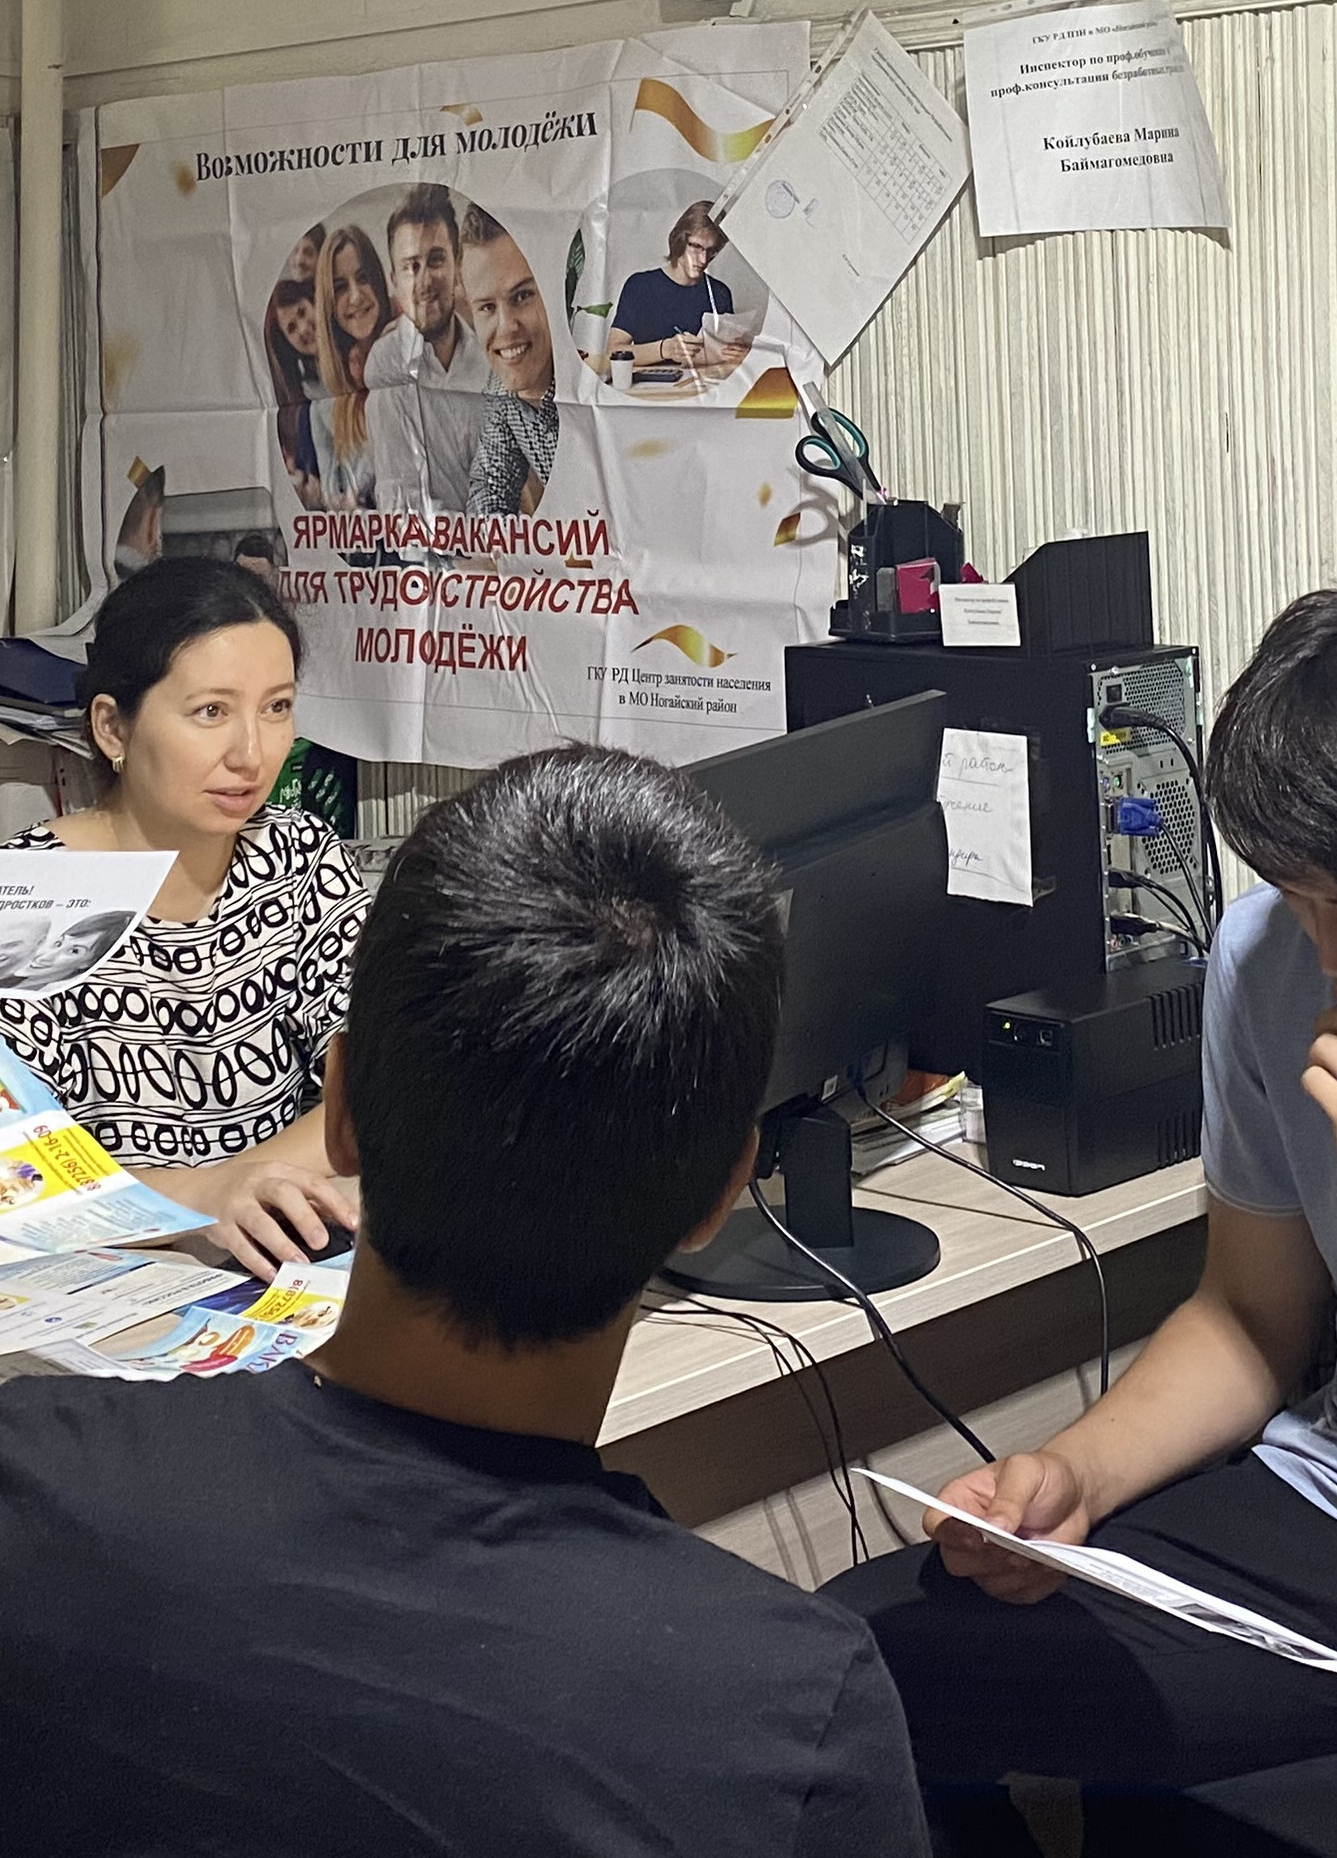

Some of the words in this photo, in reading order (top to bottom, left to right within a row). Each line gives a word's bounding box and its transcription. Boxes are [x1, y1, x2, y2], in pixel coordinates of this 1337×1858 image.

[1020, 58, 1086, 75] Инспектор
[1089, 55, 1104, 66] по
[391, 133, 446, 166] для
[456, 111, 598, 157] молодёжи
[1043, 132, 1130, 151] Койлубаева
[1135, 127, 1180, 143] Марина
[1060, 152, 1174, 172] Баймагомедовна
[293, 513, 427, 549] ЯРМАРКА
[433, 509, 610, 556] ВАКАНСИЙ
[334, 567, 640, 615] ТРУДОУСТРОЙСТВА
[355, 623, 528, 674] МОЛОДЁЖИ
[587, 666, 607, 681] ГКУ
[612, 667, 629, 685] РД
[631, 668, 663, 688] Центр
[664, 674, 714, 688] занятости
[716, 677, 772, 692] населения
[619, 695, 626, 705] в
[629, 692, 649, 706] МО
[650, 693, 704, 711] Ногайский
[706, 699, 738, 715] район
